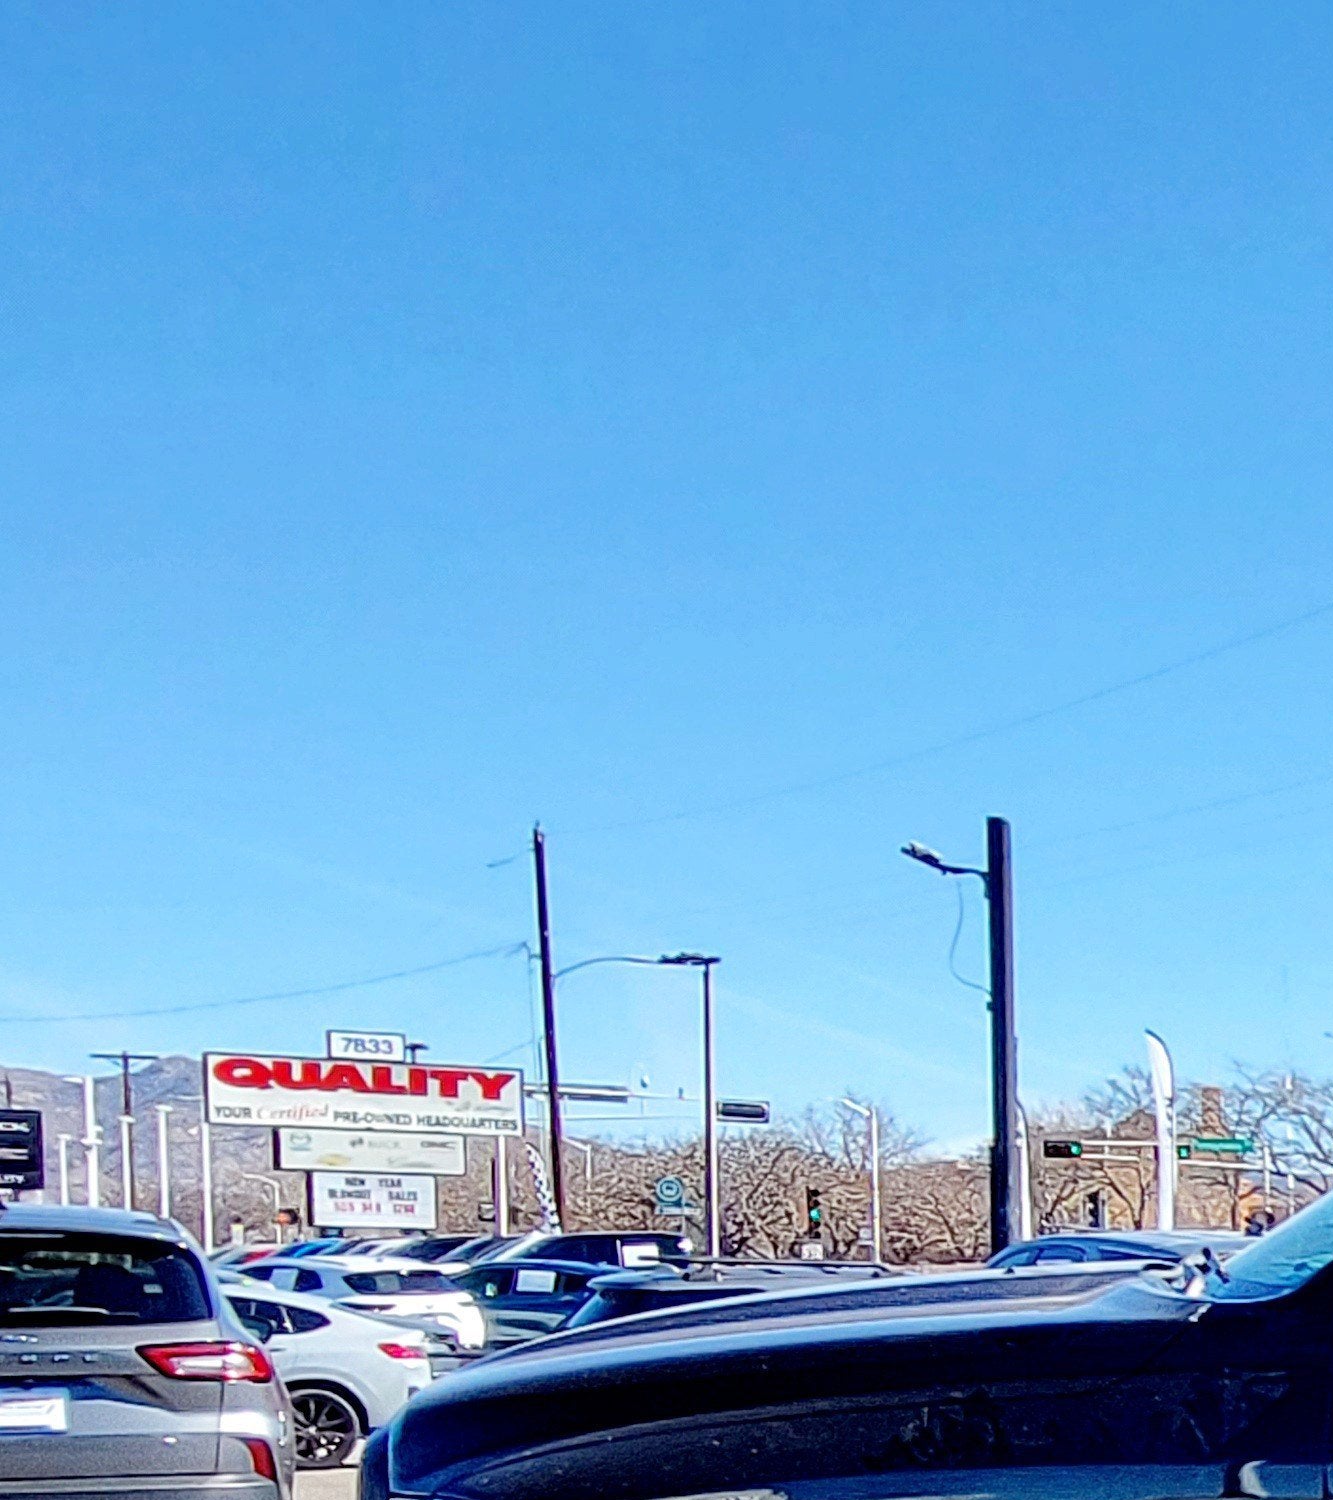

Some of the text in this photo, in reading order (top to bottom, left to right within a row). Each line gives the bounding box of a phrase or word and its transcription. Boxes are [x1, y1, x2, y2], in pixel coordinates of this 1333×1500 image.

[340, 1036, 394, 1055] 7833
[212, 1057, 517, 1101] QUALITY
[213, 1103, 519, 1132] YOUR Certified PRE-OWNED HEADQUARTERS
